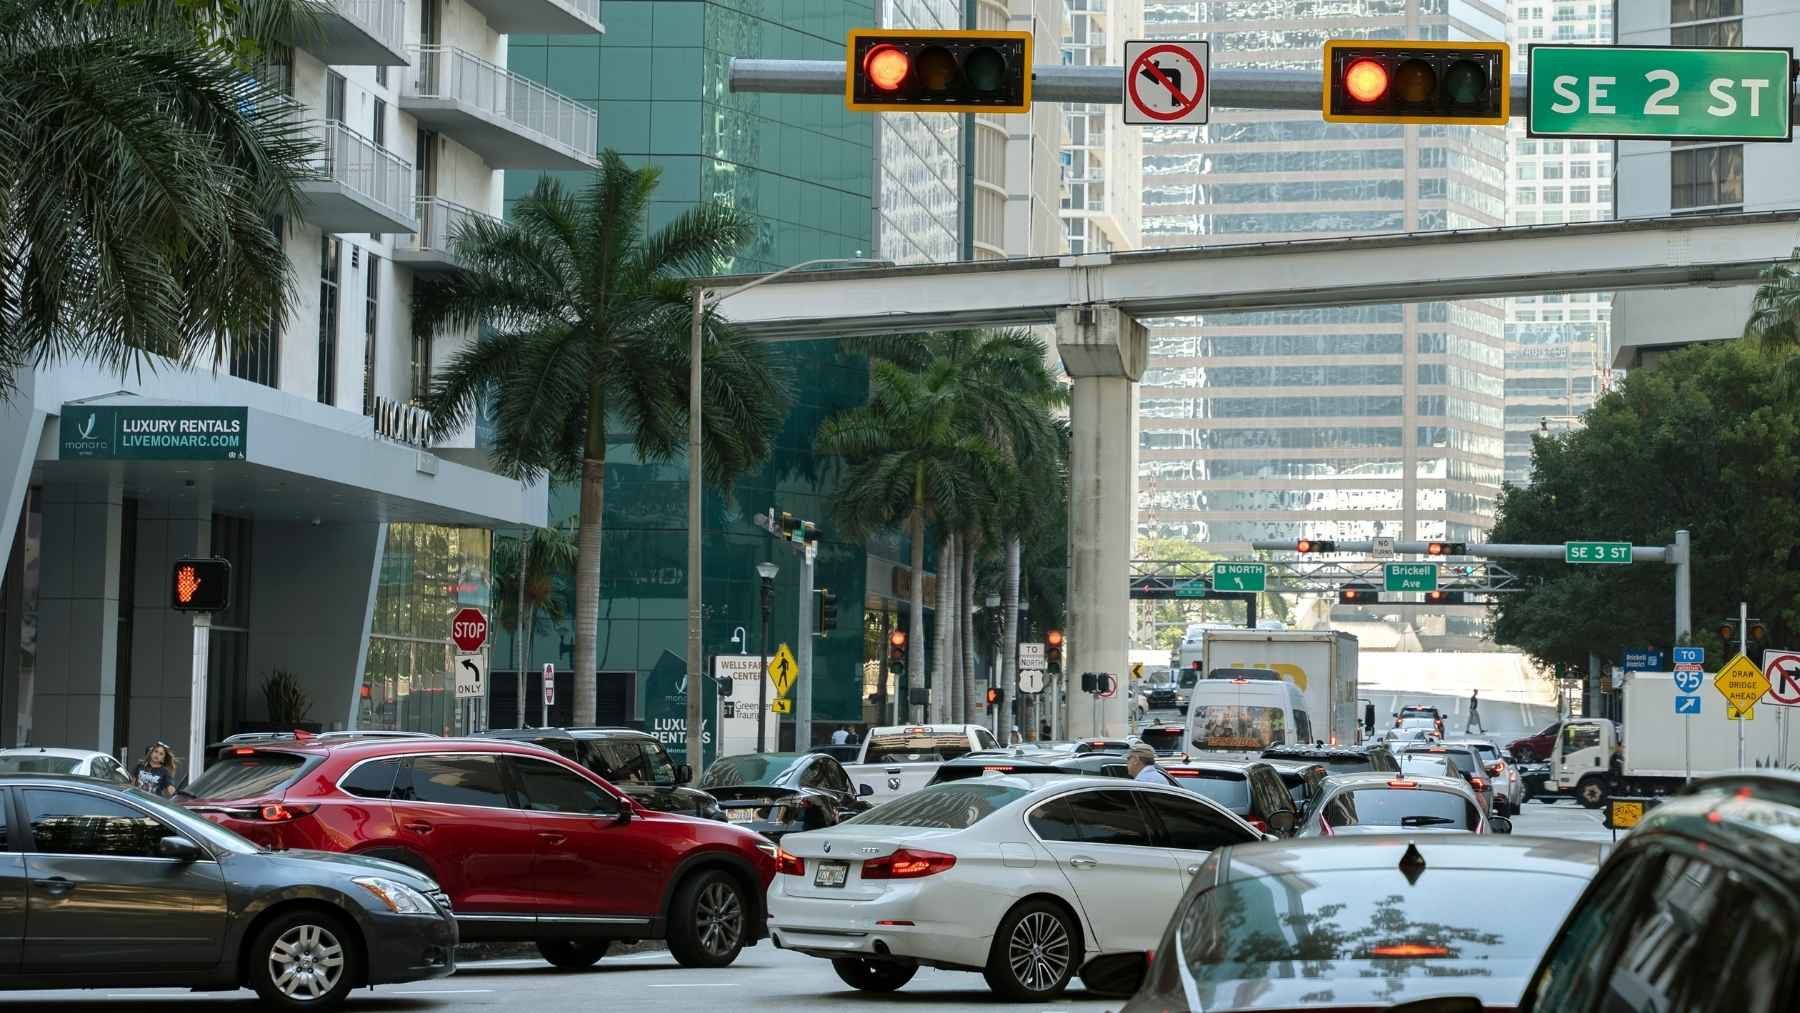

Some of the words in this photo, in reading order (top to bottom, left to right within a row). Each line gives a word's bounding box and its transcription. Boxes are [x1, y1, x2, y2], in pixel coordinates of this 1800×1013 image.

[1551, 75, 1617, 114] SE
[1643, 69, 1680, 115] 2
[1707, 78, 1769, 117] ST
[123, 419, 177, 432] LUXURY
[180, 419, 240, 432] RENTALS
[64, 440, 107, 449] monarc
[123, 435, 239, 447] LIVEMONARC.COM
[1571, 547, 1588, 558] SE
[1594, 546, 1605, 559] 3
[1611, 547, 1627, 558] ST
[1229, 565, 1263, 574] NORTH
[1392, 565, 1431, 576] Brickell
[1402, 579, 1421, 588] Ave
[454, 622, 485, 638] STOP
[1026, 646, 1039, 654] TO
[1681, 650, 1696, 660] TO
[721, 661, 747, 669] WELLS
[1020, 657, 1043, 666] NORTH
[1732, 670, 1754, 678] DRAW
[1029, 675, 1034, 688] 1
[1676, 671, 1700, 688] 95
[458, 684, 481, 694] ONLY
[1728, 681, 1757, 689] BRIDGE
[1731, 692, 1756, 700] AHEAD
[655, 718, 708, 731] LUXUY
[651, 731, 711, 744] RENTS
